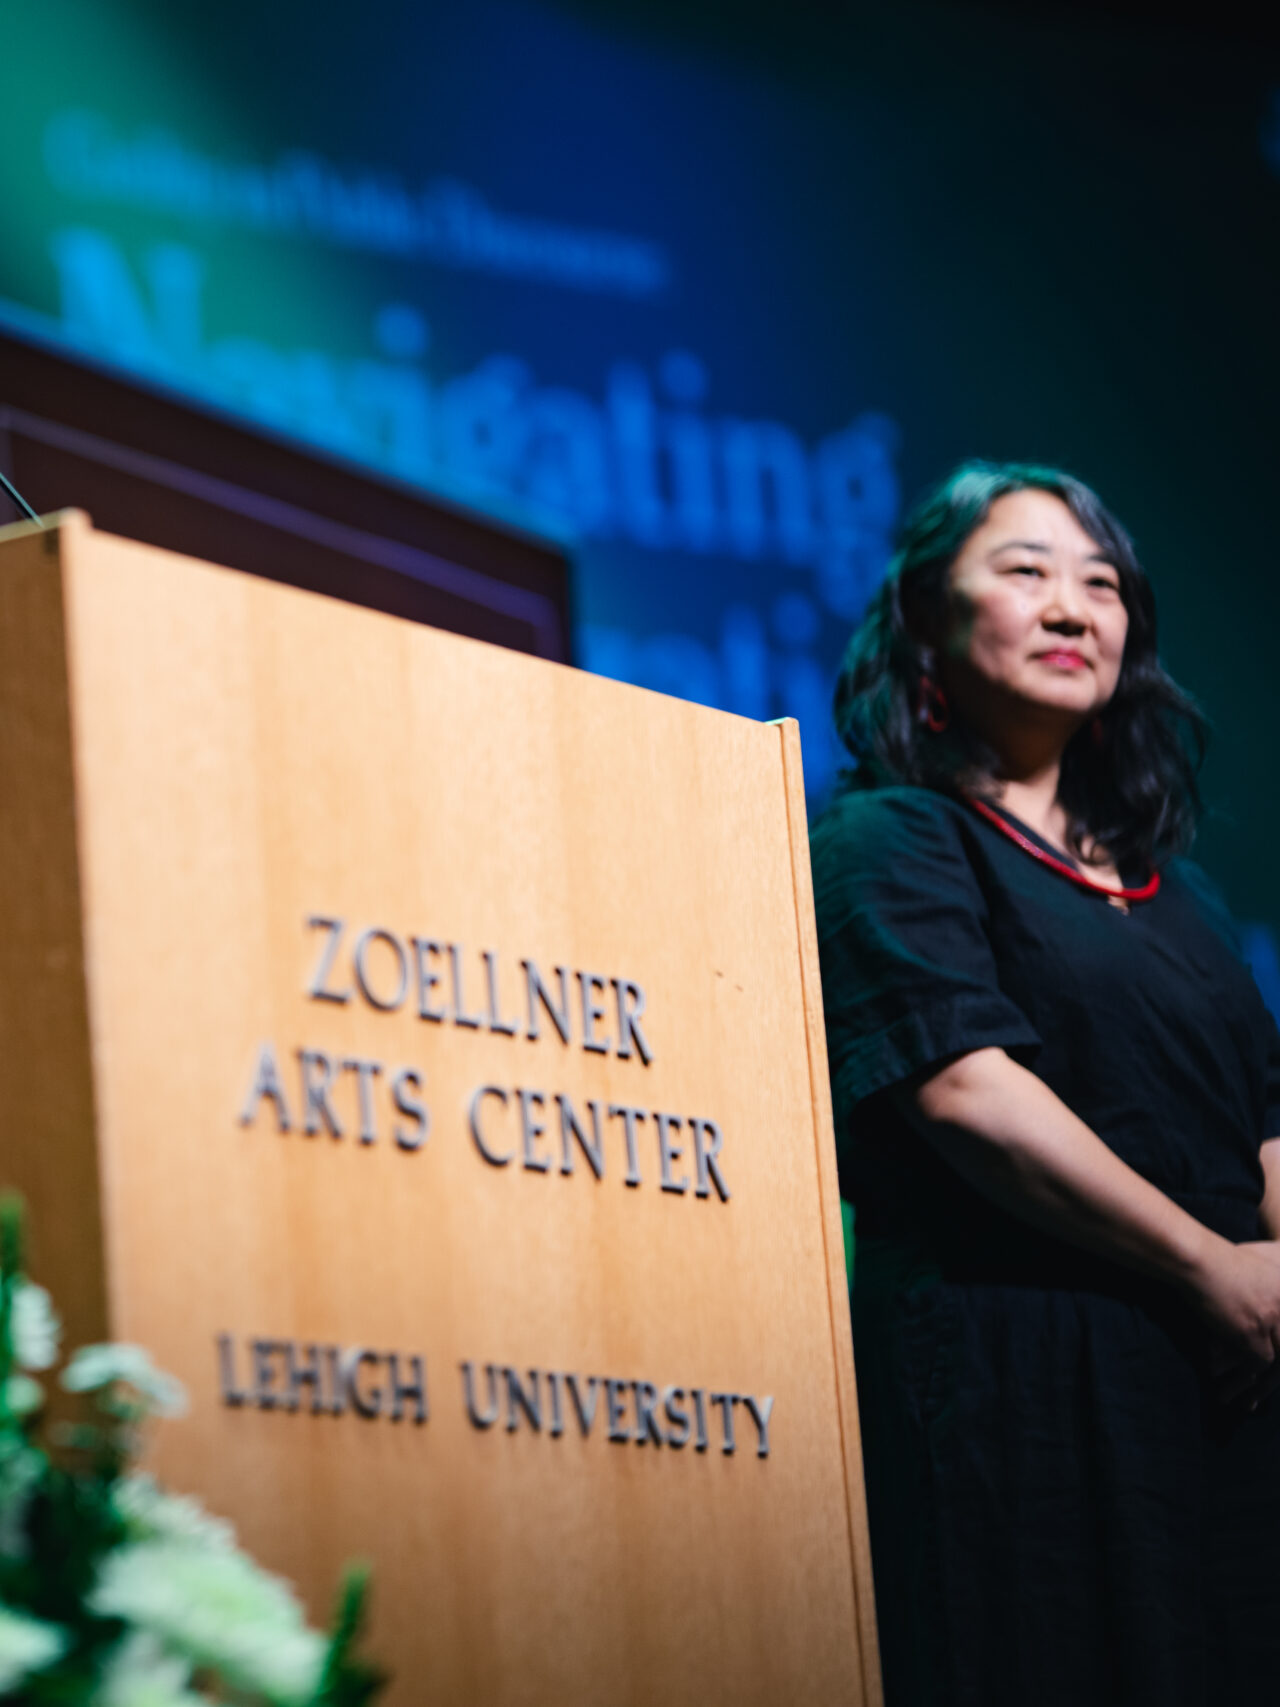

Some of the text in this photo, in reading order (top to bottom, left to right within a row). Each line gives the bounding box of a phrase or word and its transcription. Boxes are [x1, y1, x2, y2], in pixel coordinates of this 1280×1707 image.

[306, 915, 655, 1067] ZOELLNER
[238, 1040, 731, 1203] ARTS CENTER
[216, 1331, 775, 1459] LEHIGH UNIVERSITY
